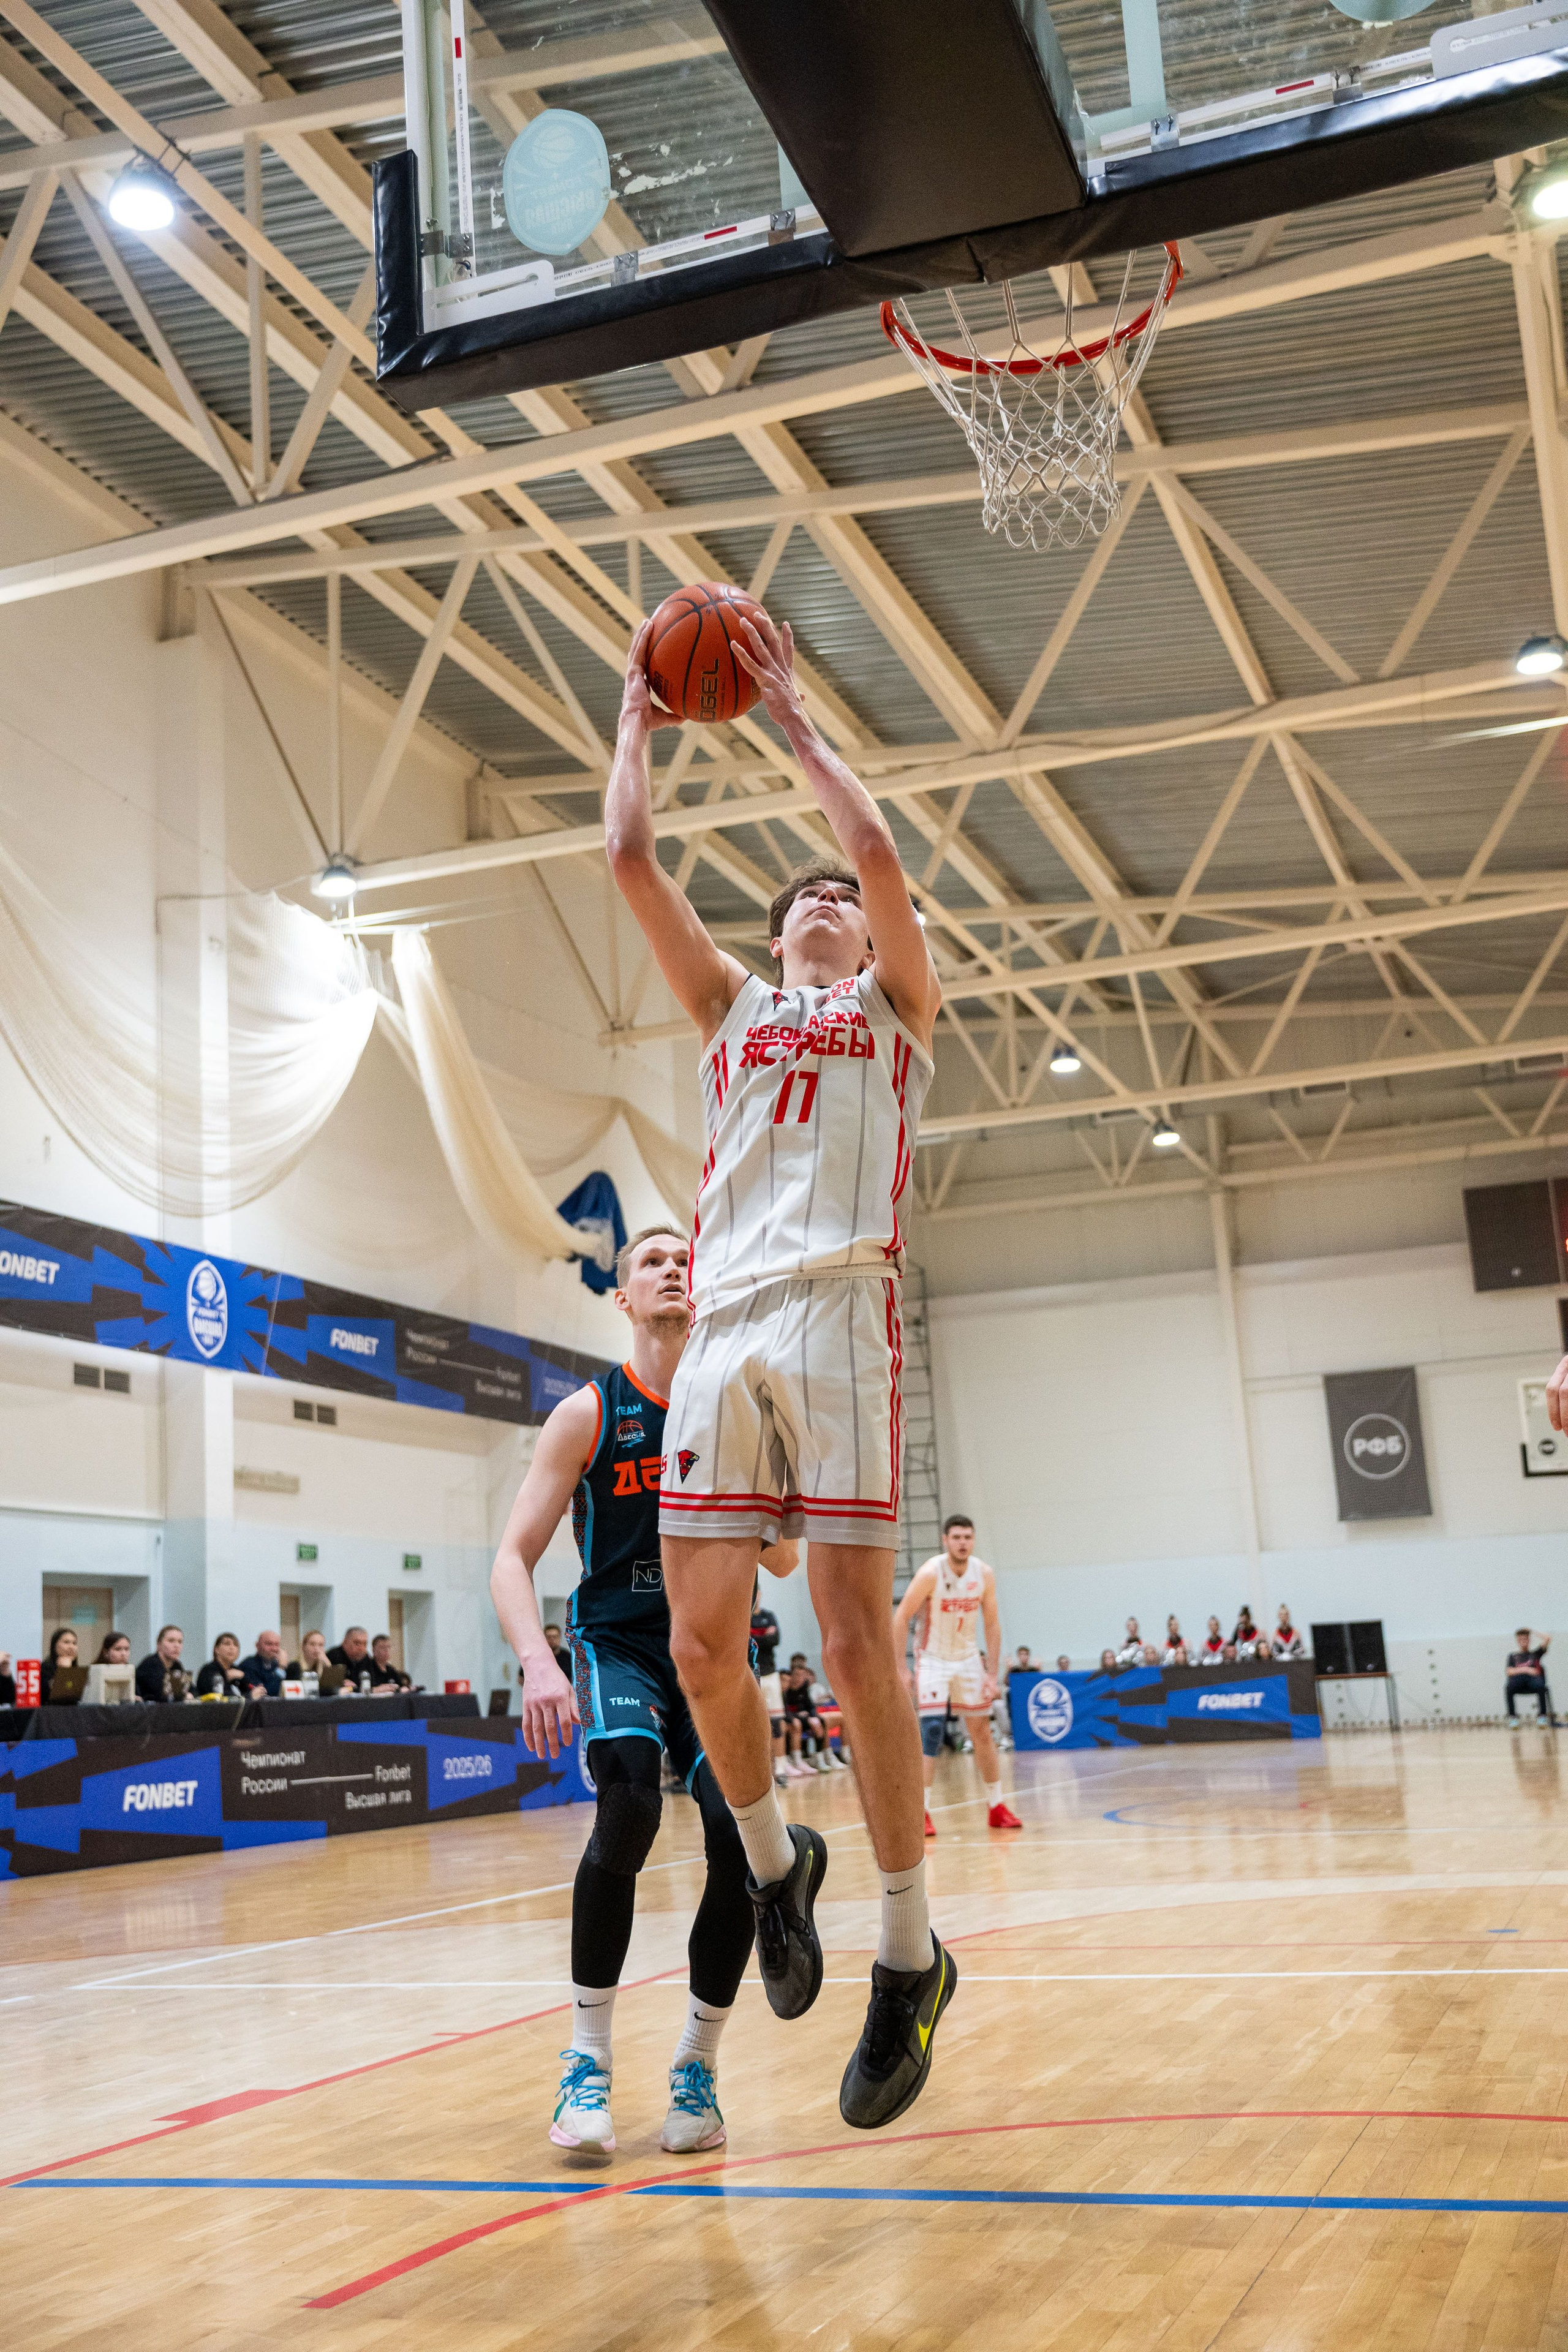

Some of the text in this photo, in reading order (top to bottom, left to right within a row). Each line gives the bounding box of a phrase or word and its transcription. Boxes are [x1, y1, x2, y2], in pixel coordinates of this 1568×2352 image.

[831, 978, 854, 993] ON
[745, 1011, 870, 1041] ЧЕБОКАСКИЕ
[739, 1025, 875, 1068] ЯСТРЕБЫ
[772, 1069, 819, 1125] 17
[0, 1251, 60, 1285] ONBET
[330, 1328, 379, 1356] FONBET
[616, 1403, 643, 1416] TEAM
[1352, 1434, 1403, 1458] РФБ
[609, 1697, 641, 1707] TEAM
[1197, 1691, 1265, 1711] FONBET
[241, 1751, 306, 1770] Чемпионат
[443, 1754, 492, 1780] 2025/26
[374, 1763, 411, 1782] Fonbet
[123, 1780, 198, 1812] FONBET
[241, 1776, 288, 1795] России
[345, 1789, 412, 1811] Высшая лига
